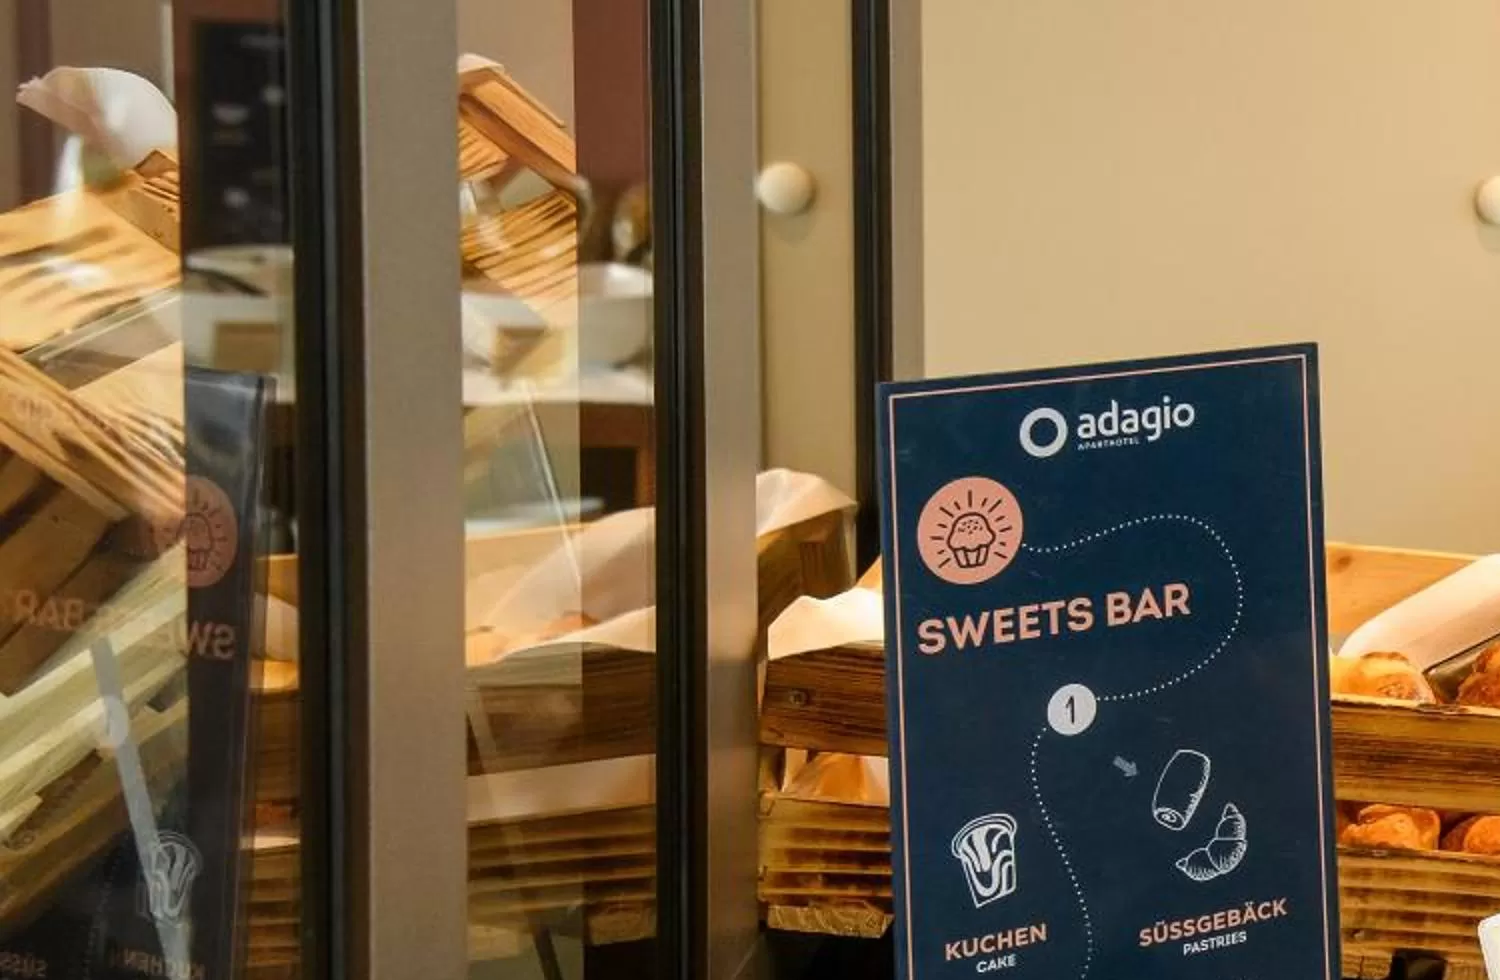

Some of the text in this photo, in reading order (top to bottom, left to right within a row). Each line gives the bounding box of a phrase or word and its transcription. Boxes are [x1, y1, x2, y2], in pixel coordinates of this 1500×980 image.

[1077, 395, 1195, 442] adagio
[917, 582, 1191, 655] SWEETS BAR
[1065, 695, 1075, 725] 1
[1139, 897, 1288, 947] SÜSSGEBÄCK
[944, 923, 1047, 961] KUCHEN
[1182, 931, 1247, 956] PASTRIES
[975, 953, 1018, 973] CAKE
